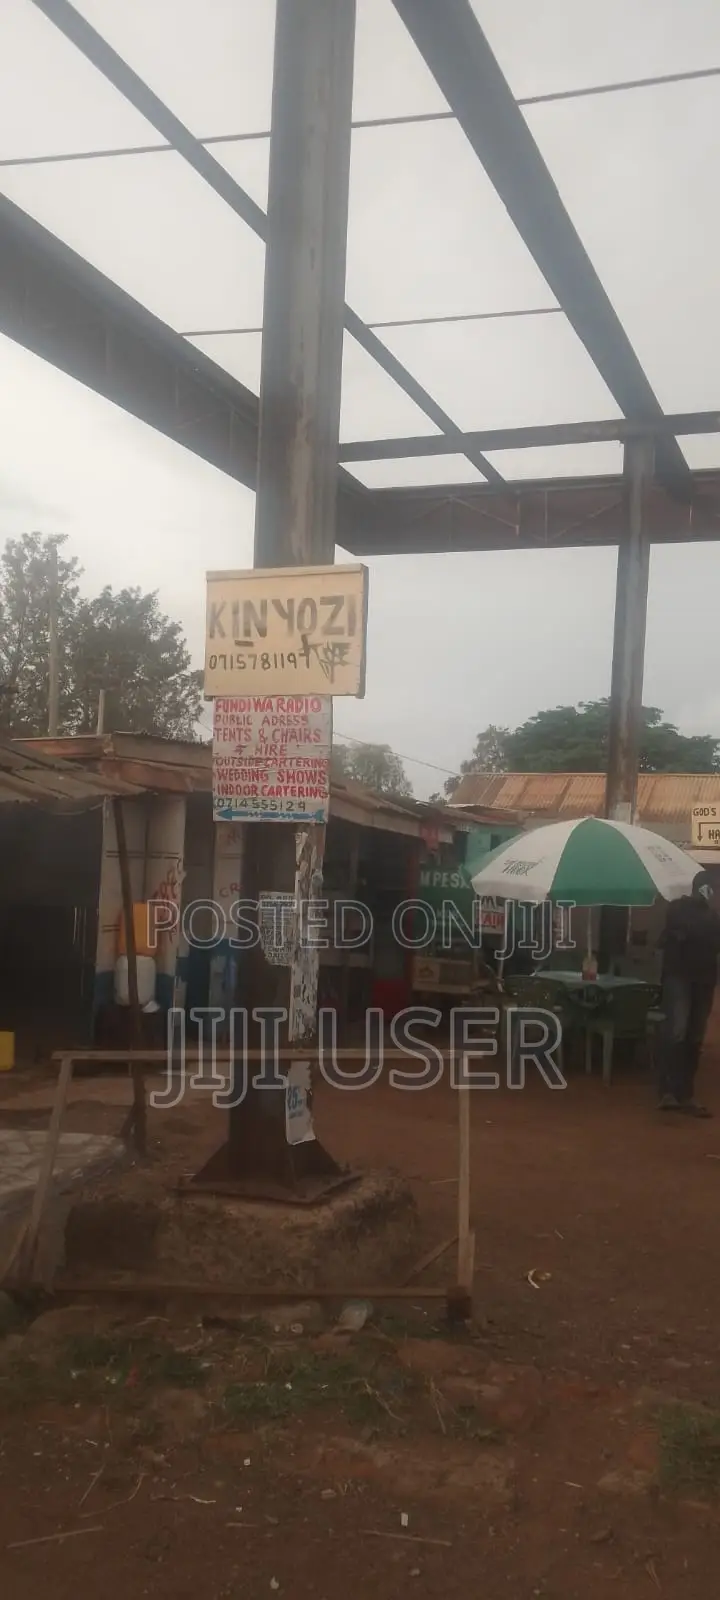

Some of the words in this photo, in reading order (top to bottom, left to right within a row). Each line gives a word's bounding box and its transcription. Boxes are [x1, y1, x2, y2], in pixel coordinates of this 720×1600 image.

[208, 594, 357, 639] KINYOZI
[276, 696, 322, 713] RADIO
[215, 713, 253, 726] PUBLIC
[261, 714, 309, 727] ADRESS
[214, 727, 252, 743] TENTS
[271, 727, 323, 743] CHAIRS
[254, 743, 288, 757] HIRE
[216, 767, 269, 783] WEDDING
[276, 768, 326, 784] SHOWS
[217, 783, 259, 798] INDOOR
[260, 784, 329, 799] CARTERING
[692, 806, 717, 817] GOD'S
